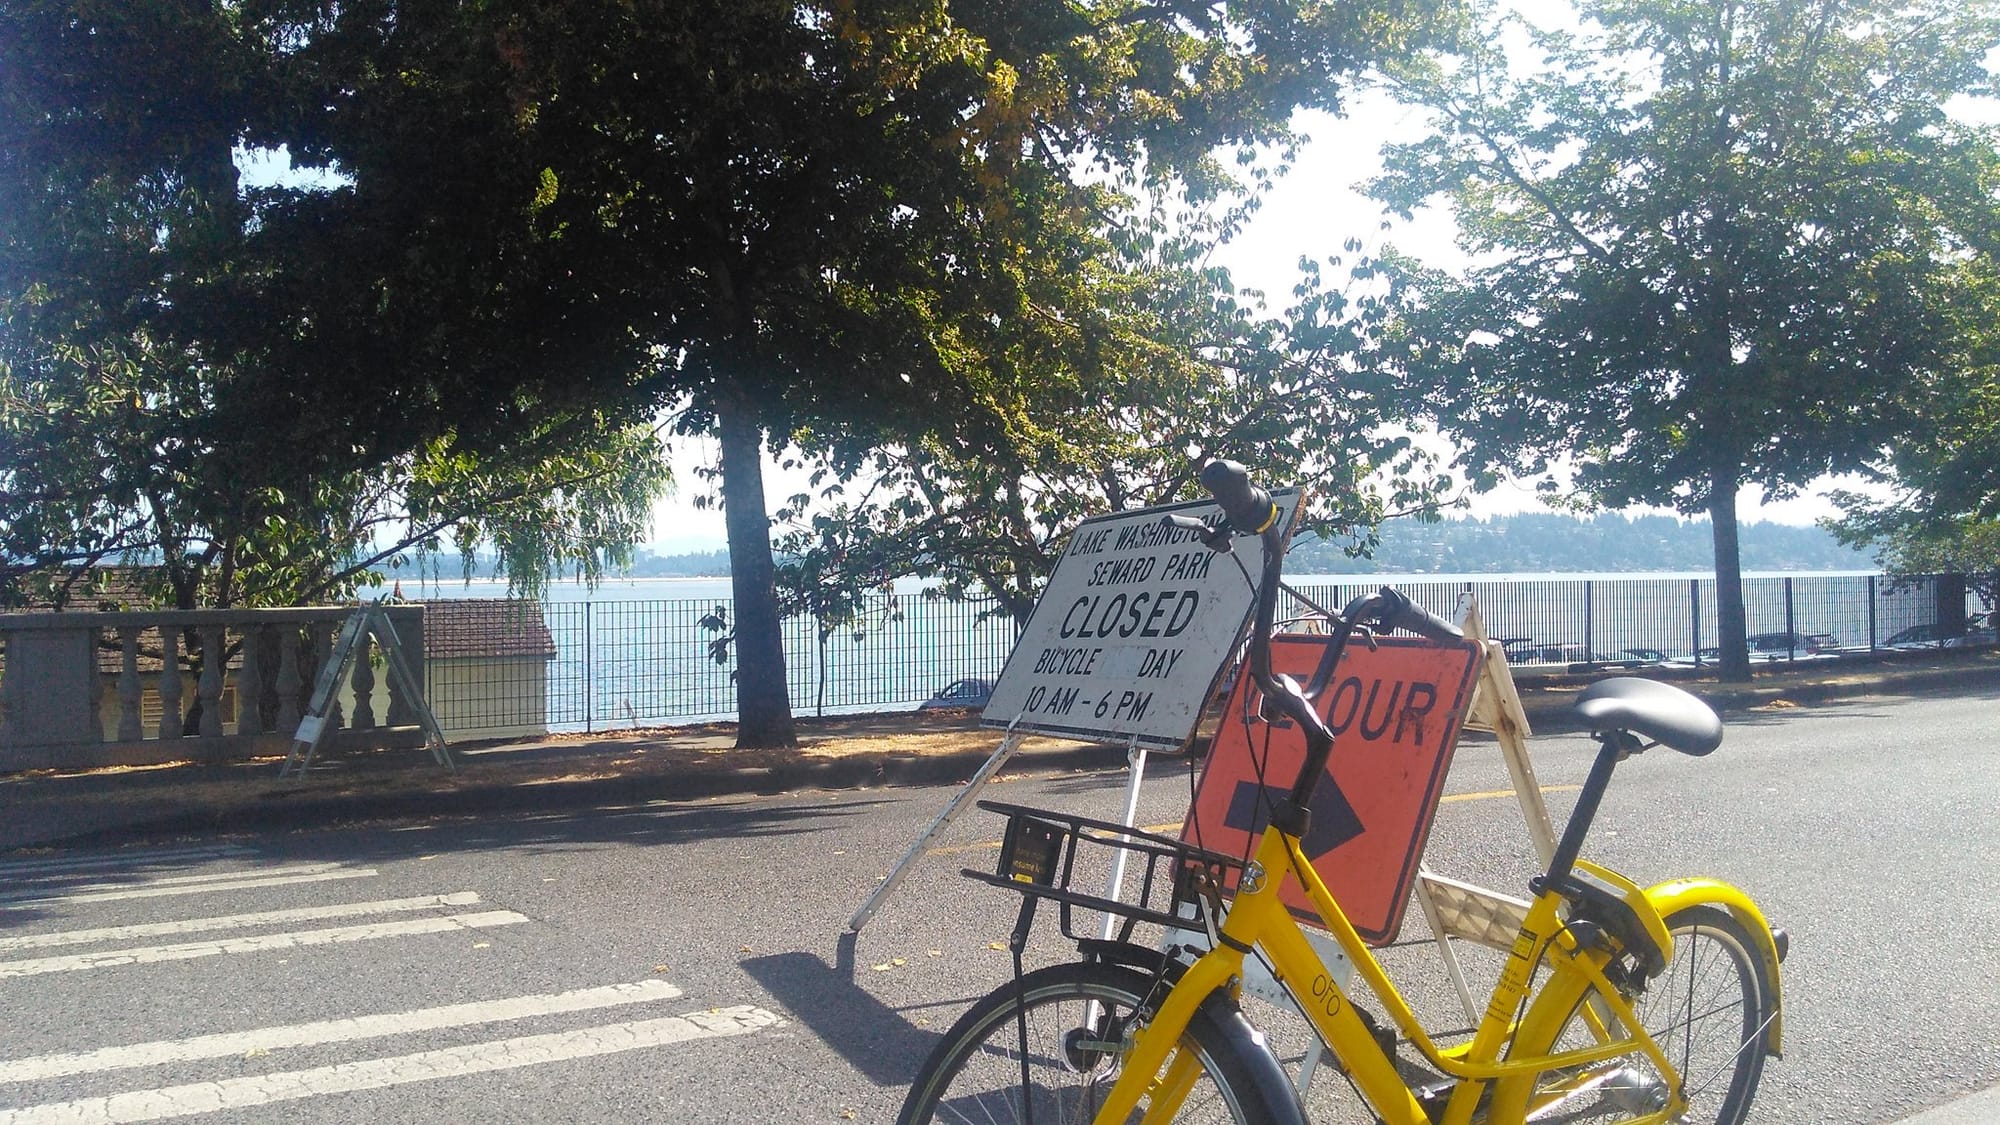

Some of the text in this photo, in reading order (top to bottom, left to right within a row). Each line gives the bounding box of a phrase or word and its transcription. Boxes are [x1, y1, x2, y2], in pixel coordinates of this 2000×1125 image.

[1070, 528, 1112, 557] LAKE
[1087, 551, 1216, 587] SEWARD PARK
[1059, 589, 1200, 639] CLOSED
[1033, 648, 1184, 679] BICYCLE DAY
[1022, 686, 1047, 713] 10
[1042, 687, 1080, 715] AM
[1094, 690, 1113, 719] 6
[1112, 691, 1154, 722] PM
[1241, 673, 1438, 746] OUR
